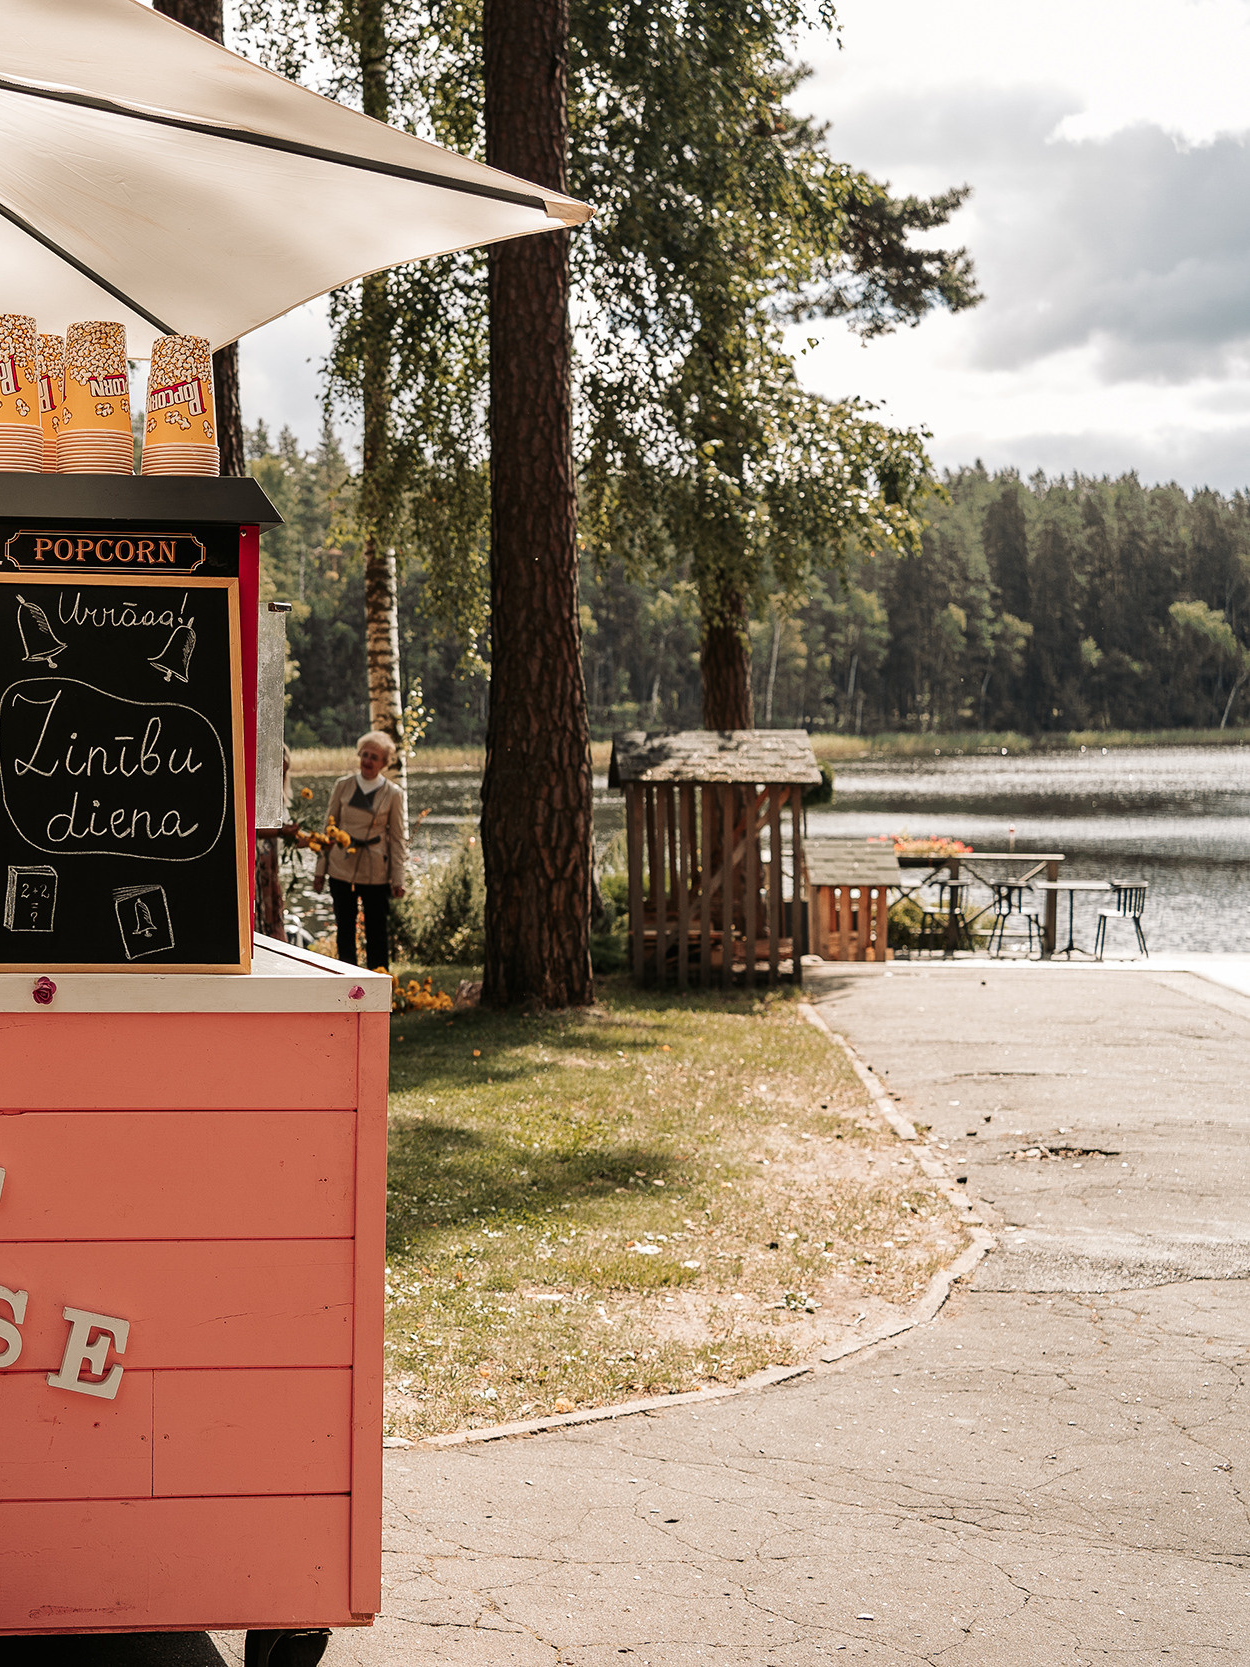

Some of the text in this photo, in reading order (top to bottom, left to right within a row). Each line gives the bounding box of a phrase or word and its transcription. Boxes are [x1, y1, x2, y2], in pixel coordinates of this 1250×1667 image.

[34, 538, 177, 564] POPCORN
[12, 689, 202, 776] Zinību
[46, 791, 199, 842] diena
